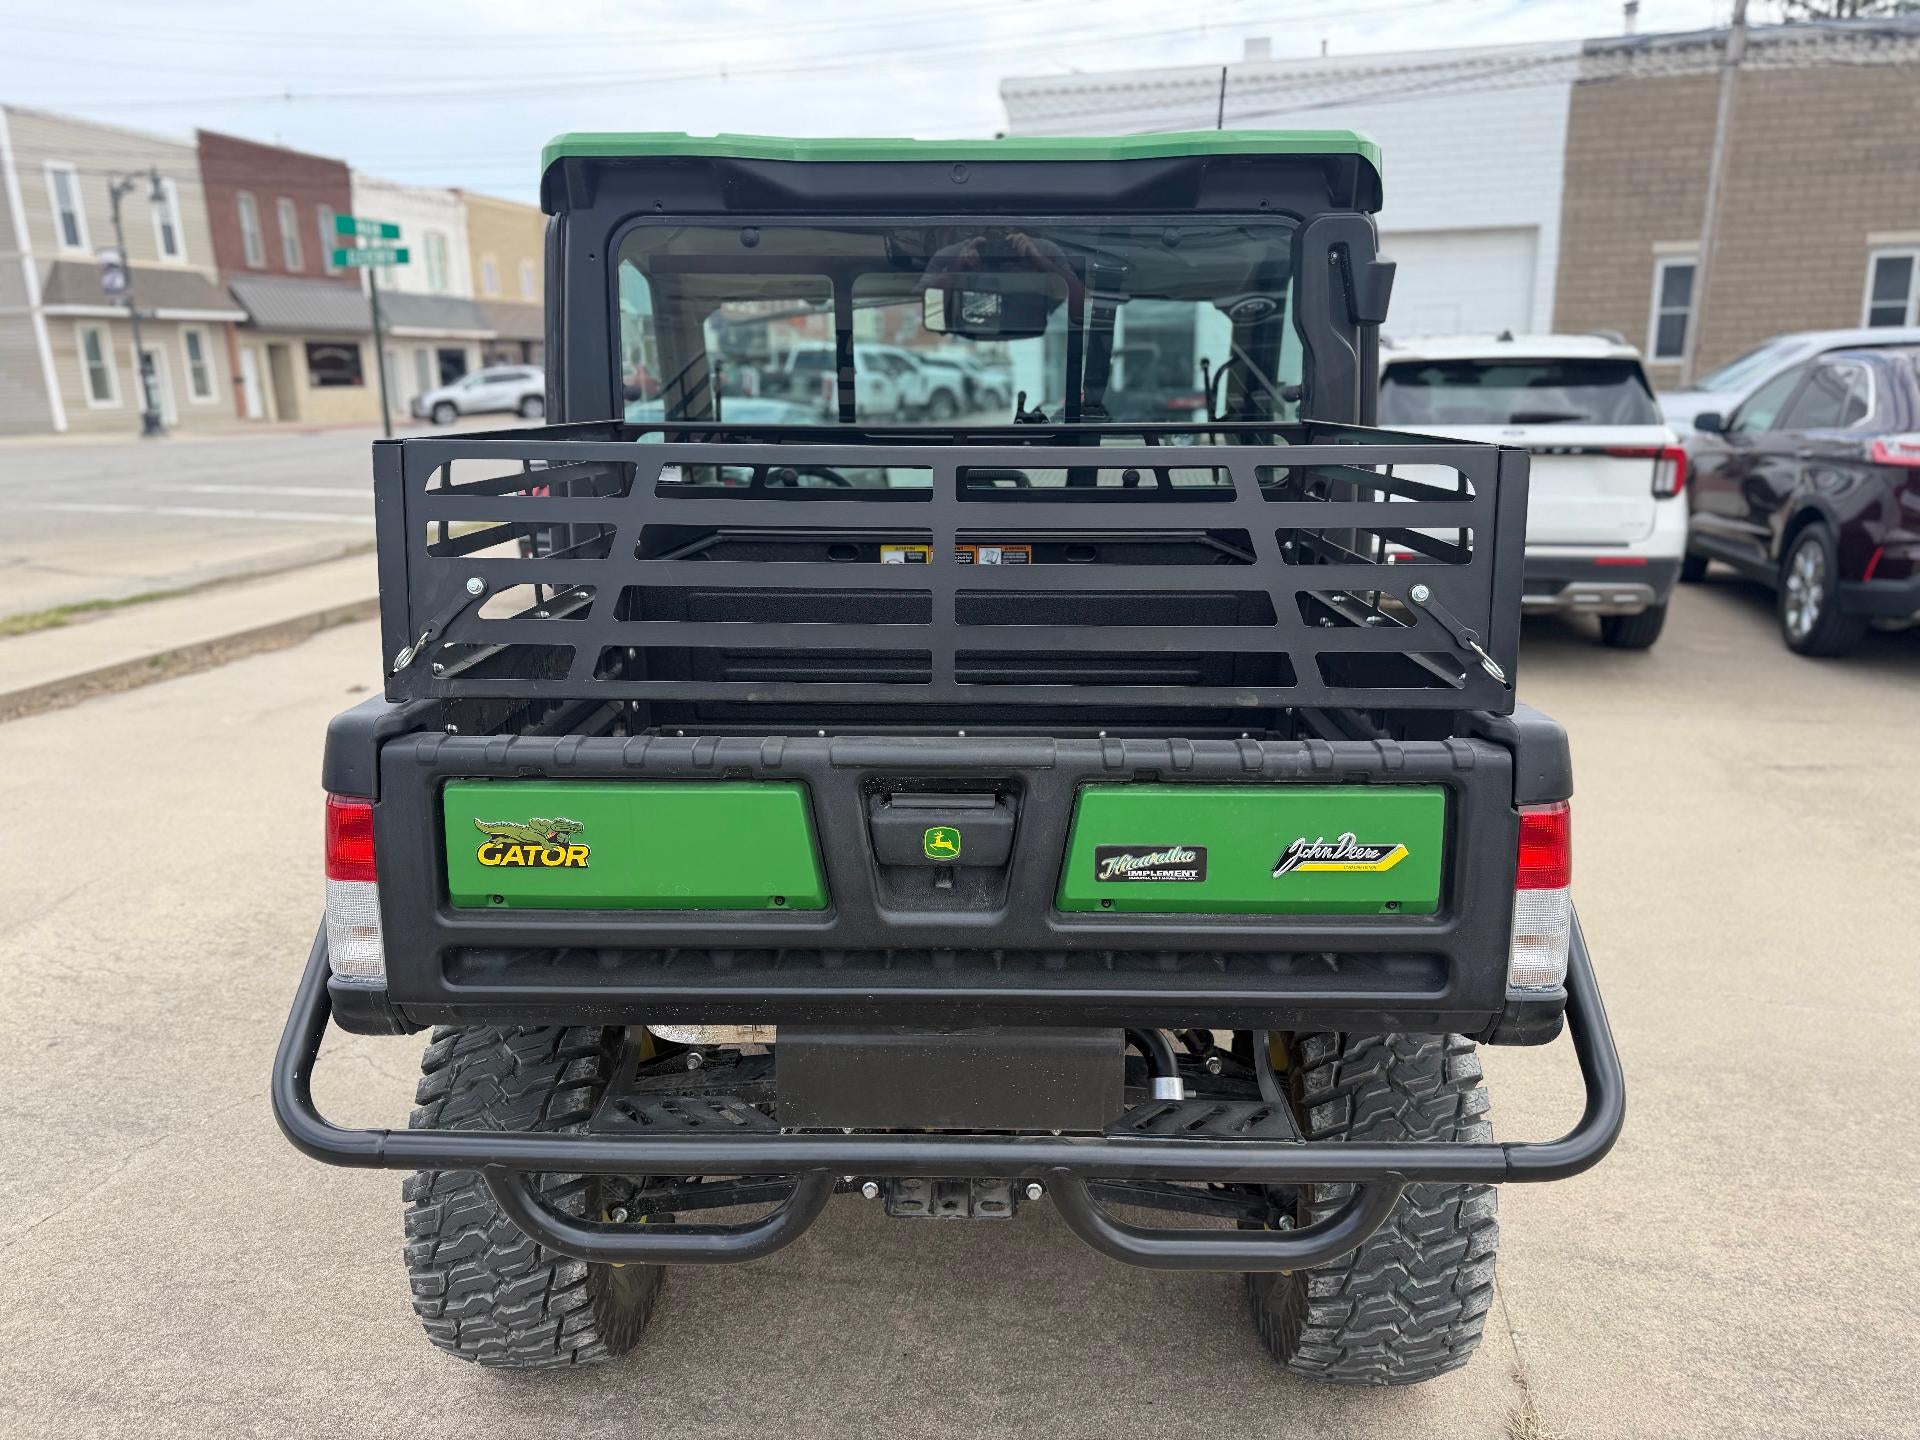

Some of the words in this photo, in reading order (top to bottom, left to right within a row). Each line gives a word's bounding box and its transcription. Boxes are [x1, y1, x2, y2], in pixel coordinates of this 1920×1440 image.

[477, 842, 590, 867] GATOR
[1272, 836, 1334, 878] John
[1331, 831, 1381, 860] Deere
[1127, 869, 1199, 877] IMPLEMENT
